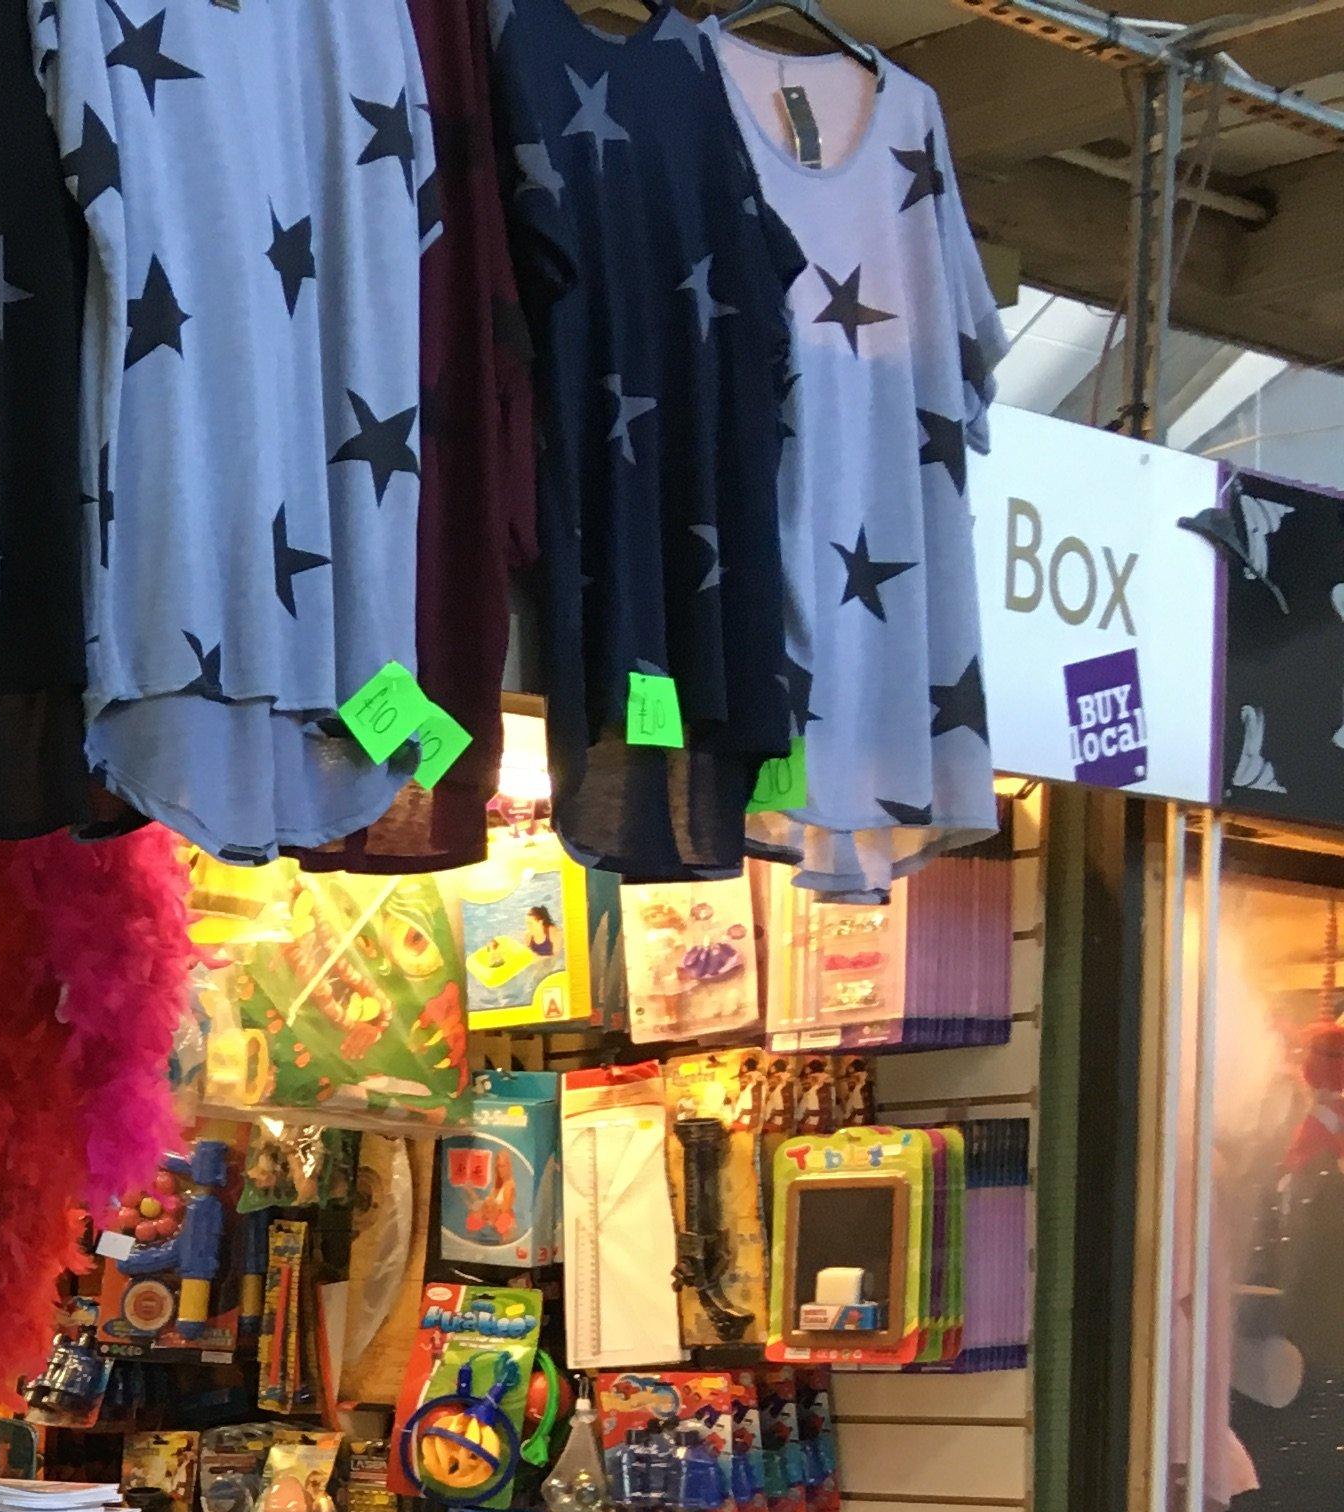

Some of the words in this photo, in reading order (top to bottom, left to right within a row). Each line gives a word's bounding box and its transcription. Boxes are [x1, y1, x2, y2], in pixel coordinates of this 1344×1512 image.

[354, 687, 399, 735] £10
[1076, 684, 1133, 731] BUY
[1068, 708, 1148, 766] local
